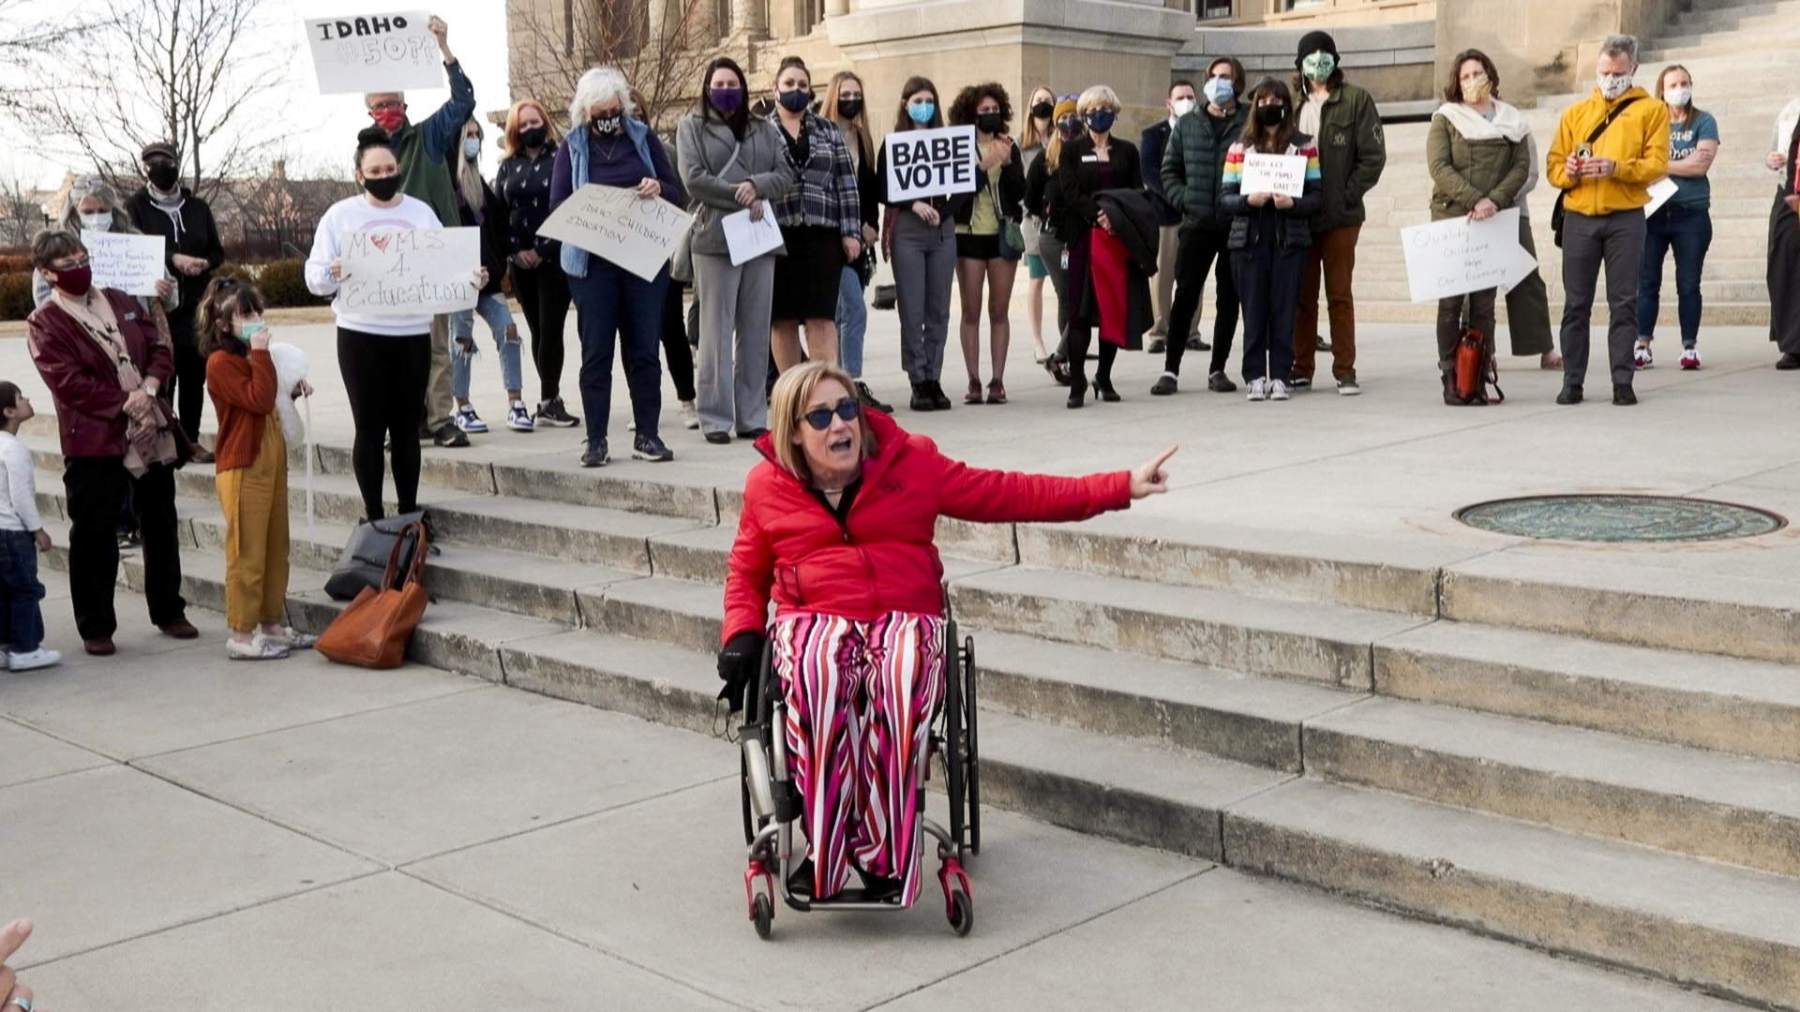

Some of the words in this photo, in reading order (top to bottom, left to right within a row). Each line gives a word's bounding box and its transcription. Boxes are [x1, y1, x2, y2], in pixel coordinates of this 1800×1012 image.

[316, 15, 408, 41] IDAHO
[892, 135, 970, 167] BABE
[894, 159, 971, 191] VOTE
[565, 214, 627, 244] EDUCATION
[617, 214, 671, 248] CHILDREN
[385, 253, 411, 276] 4
[346, 274, 468, 309] Education
